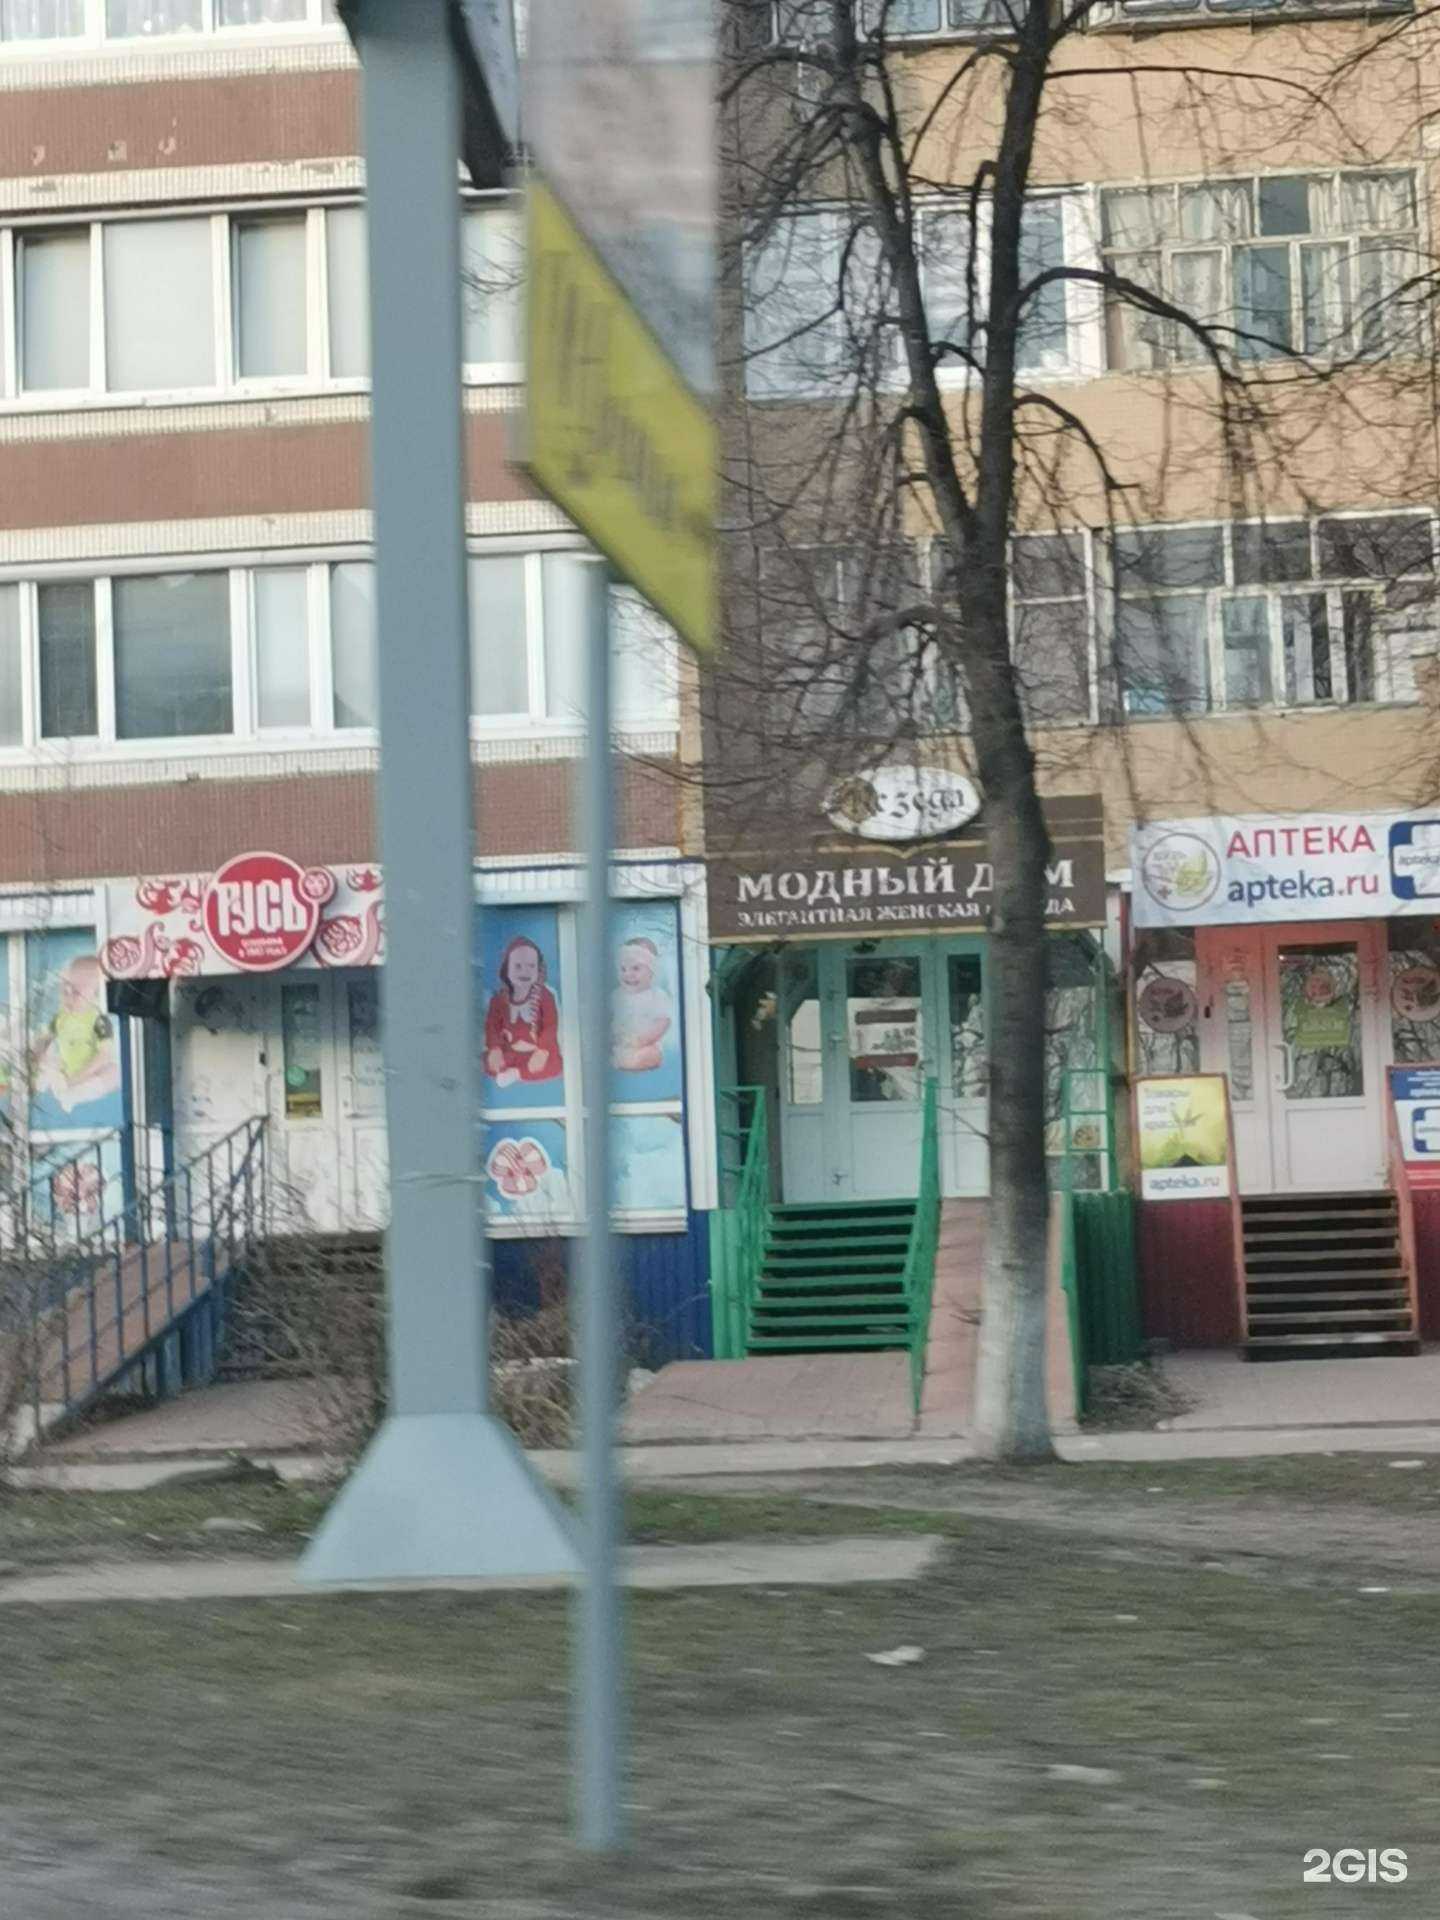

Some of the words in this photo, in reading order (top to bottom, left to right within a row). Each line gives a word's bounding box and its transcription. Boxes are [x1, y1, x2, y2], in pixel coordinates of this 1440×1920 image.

[1226, 825, 1376, 859] АПТЕКА
[737, 857, 955, 905] МОДНЫЙ
[967, 859, 1074, 899] ДМ
[1227, 870, 1379, 908] apteka.ru
[216, 878, 307, 936] РУСЬ
[877, 901, 980, 922] ЖЕНСКАЯ
